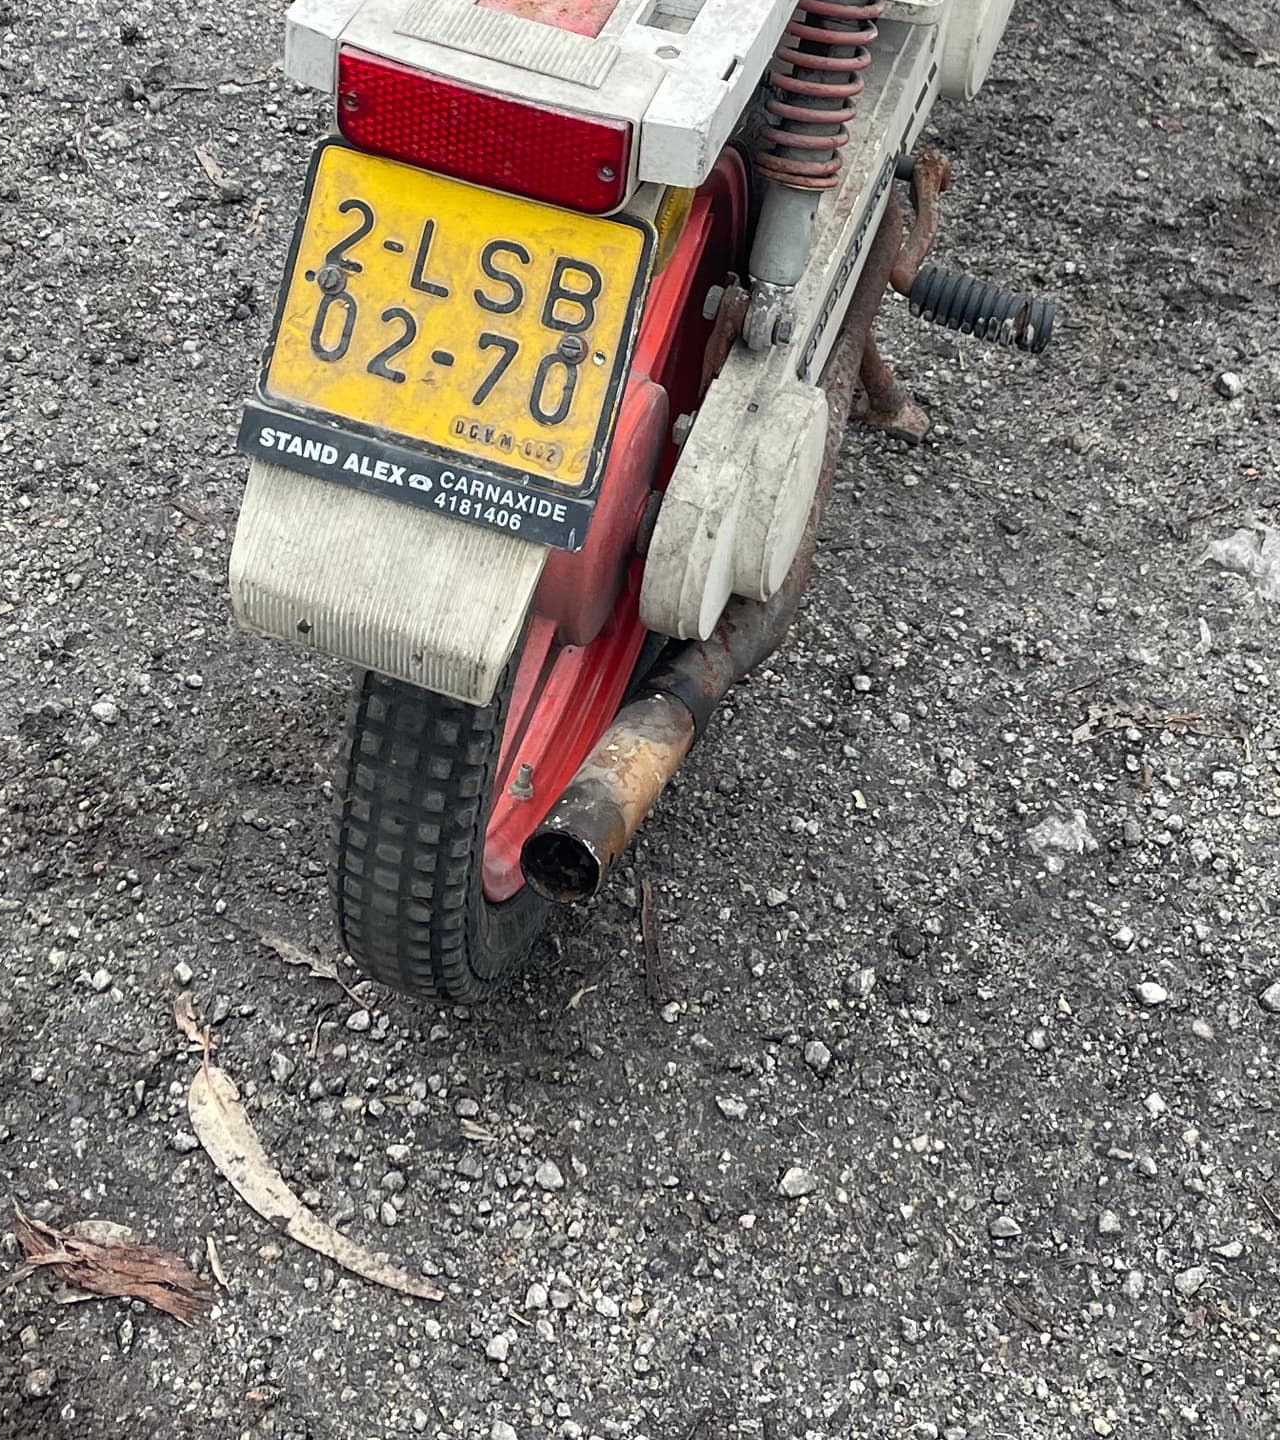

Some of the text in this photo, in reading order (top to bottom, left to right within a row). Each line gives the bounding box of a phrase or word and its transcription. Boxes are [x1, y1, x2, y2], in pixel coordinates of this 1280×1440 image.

[325, 199, 604, 334] 2-LSB
[310, 291, 579, 427] 02-70
[258, 427, 408, 487] STAND ALEX
[433, 492, 522, 532] 4181406
[440, 471, 568, 523] CARNAXIDE
